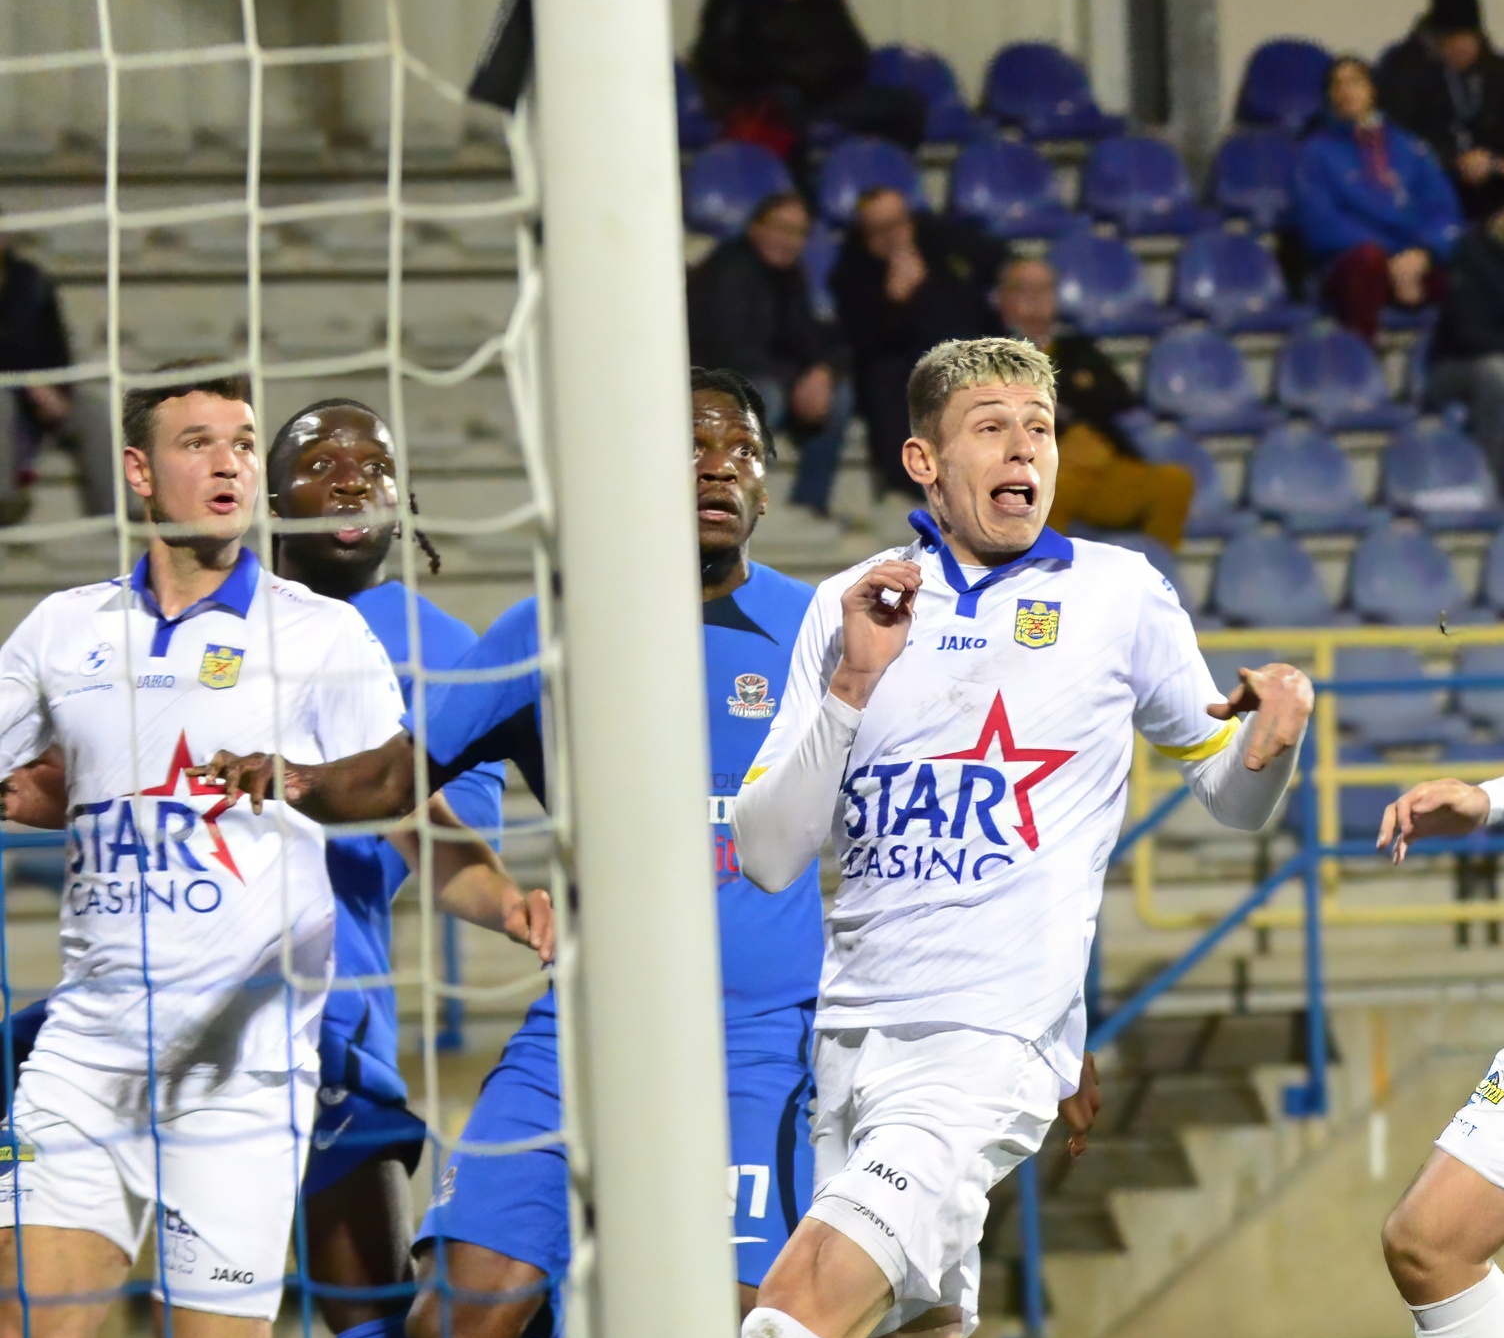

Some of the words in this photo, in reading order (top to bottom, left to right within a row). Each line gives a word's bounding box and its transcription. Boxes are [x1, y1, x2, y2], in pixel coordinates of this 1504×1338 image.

[936, 635, 987, 650] JAKO
[843, 761, 1009, 846] STAR
[69, 879, 222, 916] CASINO
[863, 1160, 908, 1191] JAKO
[210, 1267, 254, 1284] JAKO
